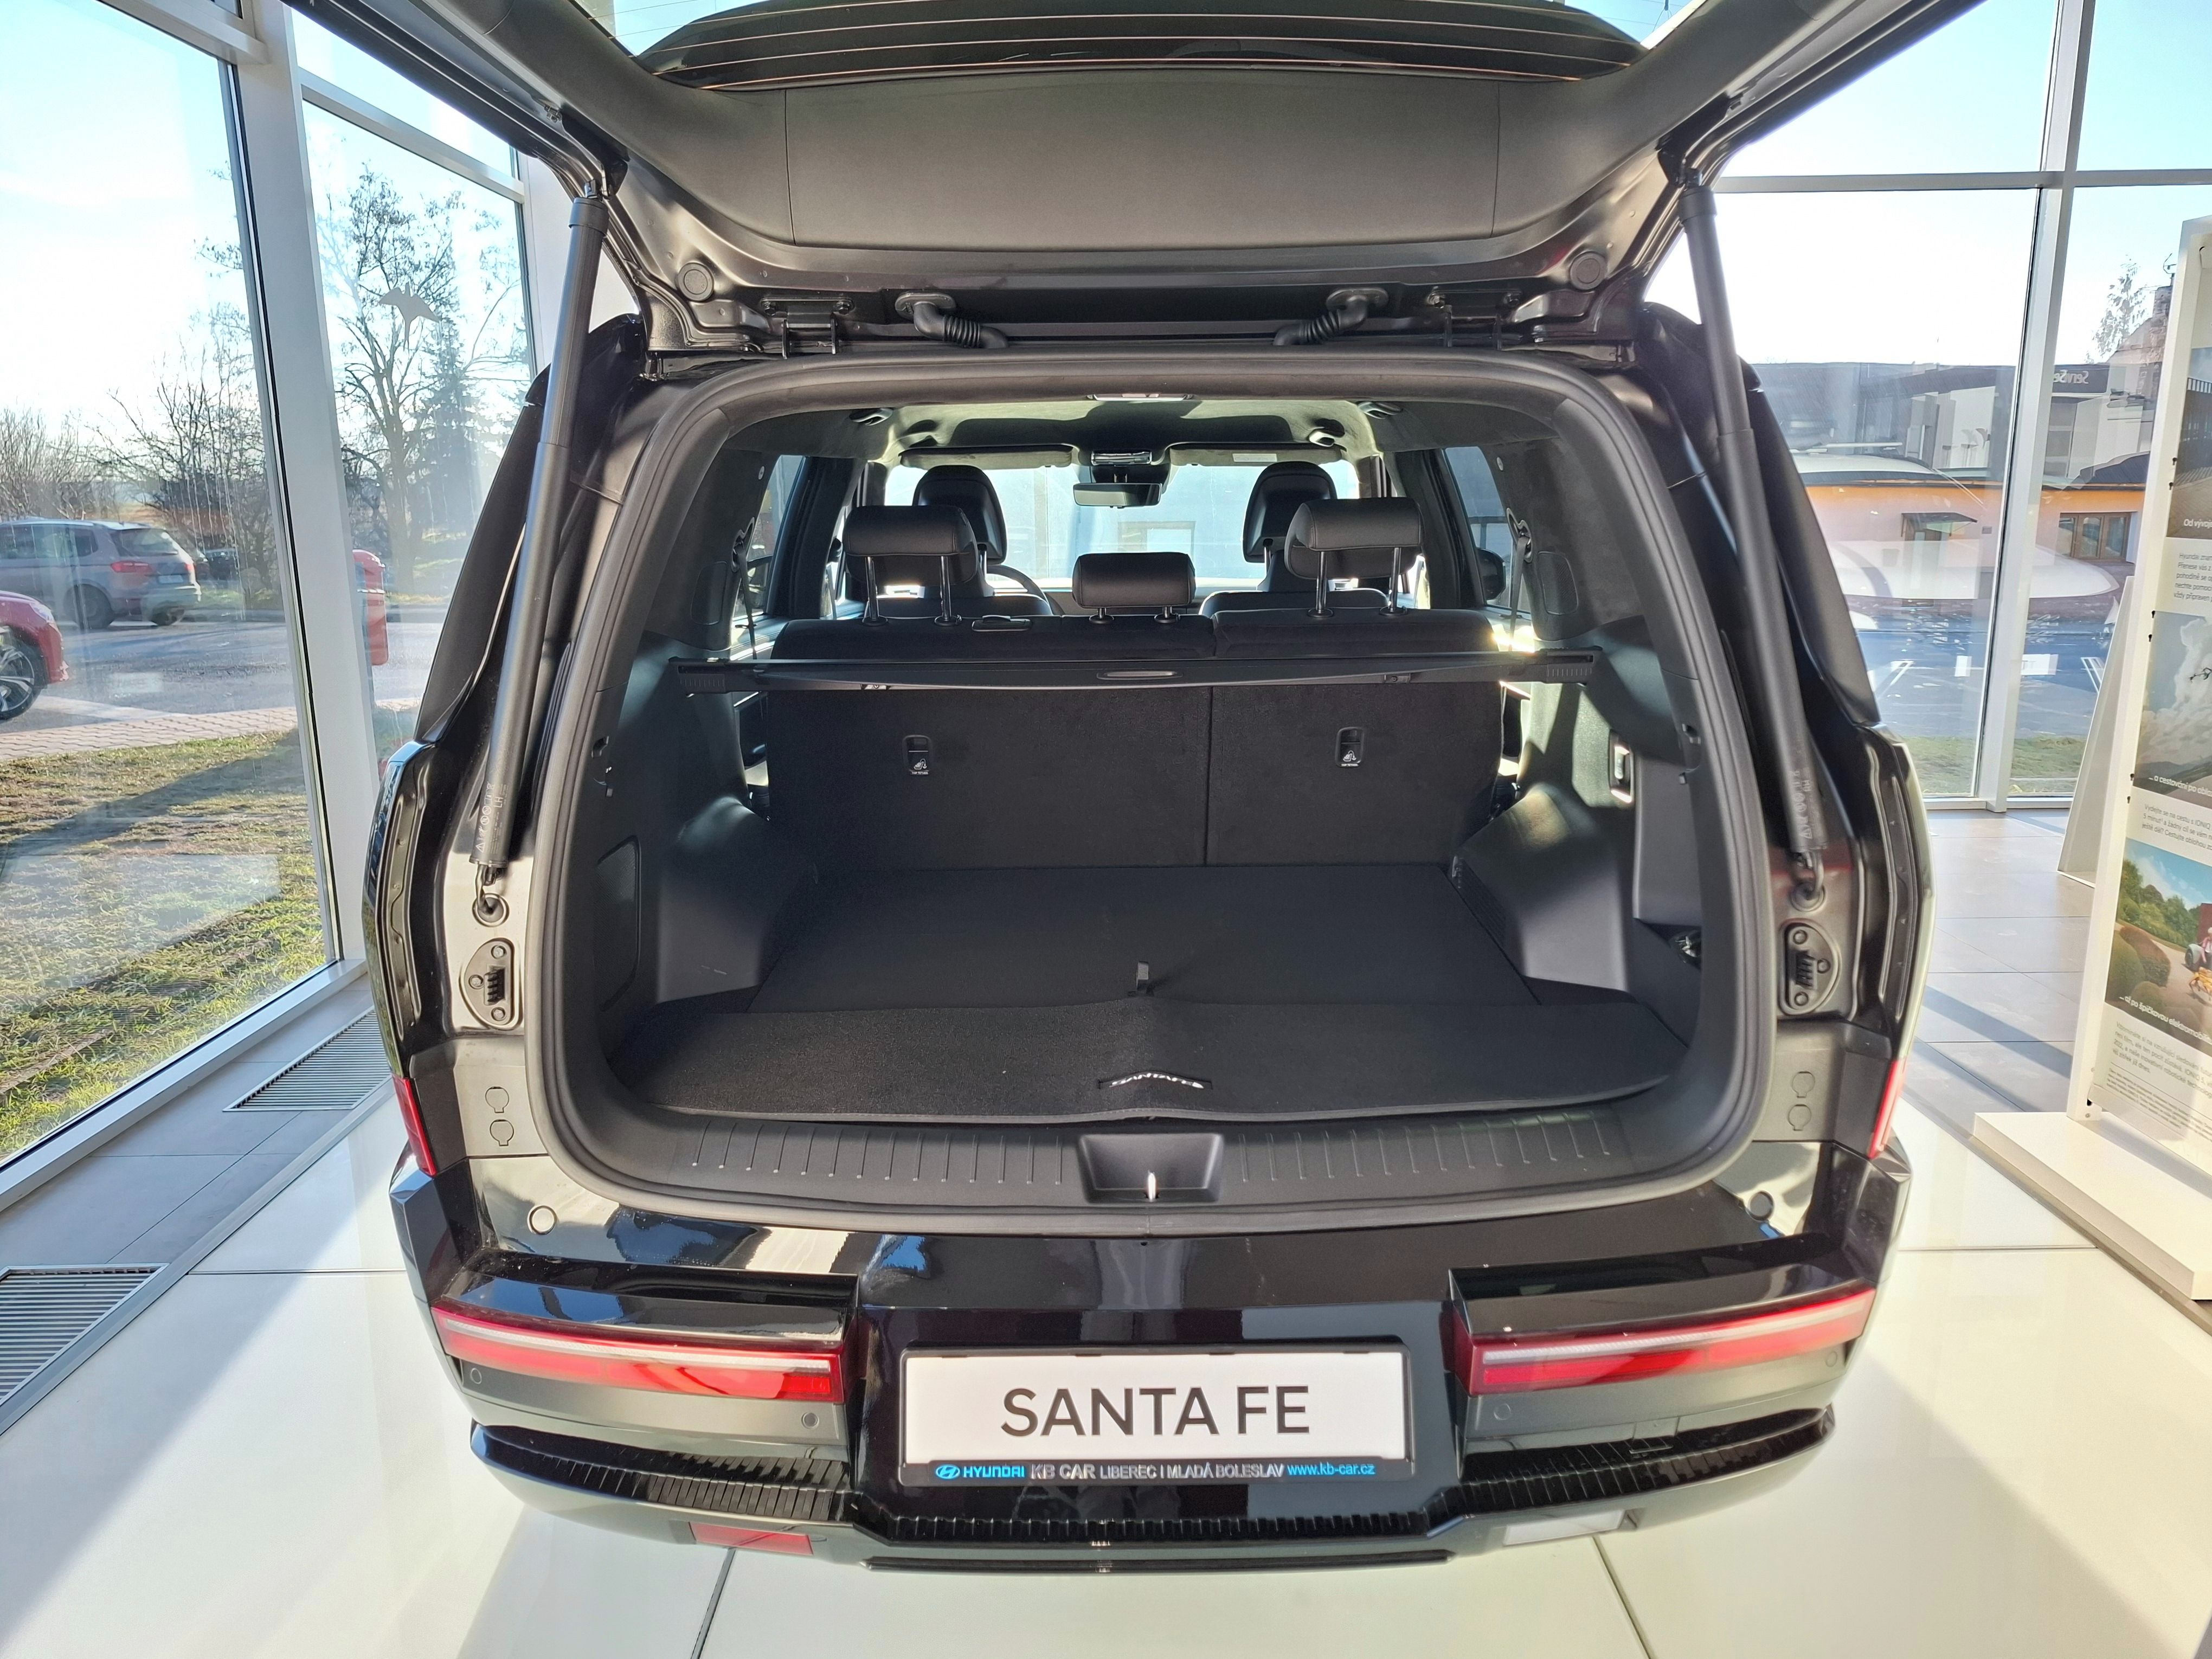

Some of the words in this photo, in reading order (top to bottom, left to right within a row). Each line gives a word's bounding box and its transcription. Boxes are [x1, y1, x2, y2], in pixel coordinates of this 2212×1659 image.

[2159, 776, 2188, 789] cestování
[494, 796, 504, 808] LH
[2139, 1002, 2169, 1023] špičkovou
[1000, 1386, 1220, 1437] SANTA
[1237, 1385, 1310, 1435] FE
[963, 1465, 1025, 1478] HYUNDAI
[1031, 1463, 1055, 1479] KB
[1059, 1463, 1096, 1480] CAR
[1100, 1464, 1157, 1480] LIBEREC
[1167, 1462, 1213, 1479] MLADÁ
[1216, 1463, 1284, 1478] BOLESLAV
[1287, 1461, 1375, 1476] www.kb-car.cz
